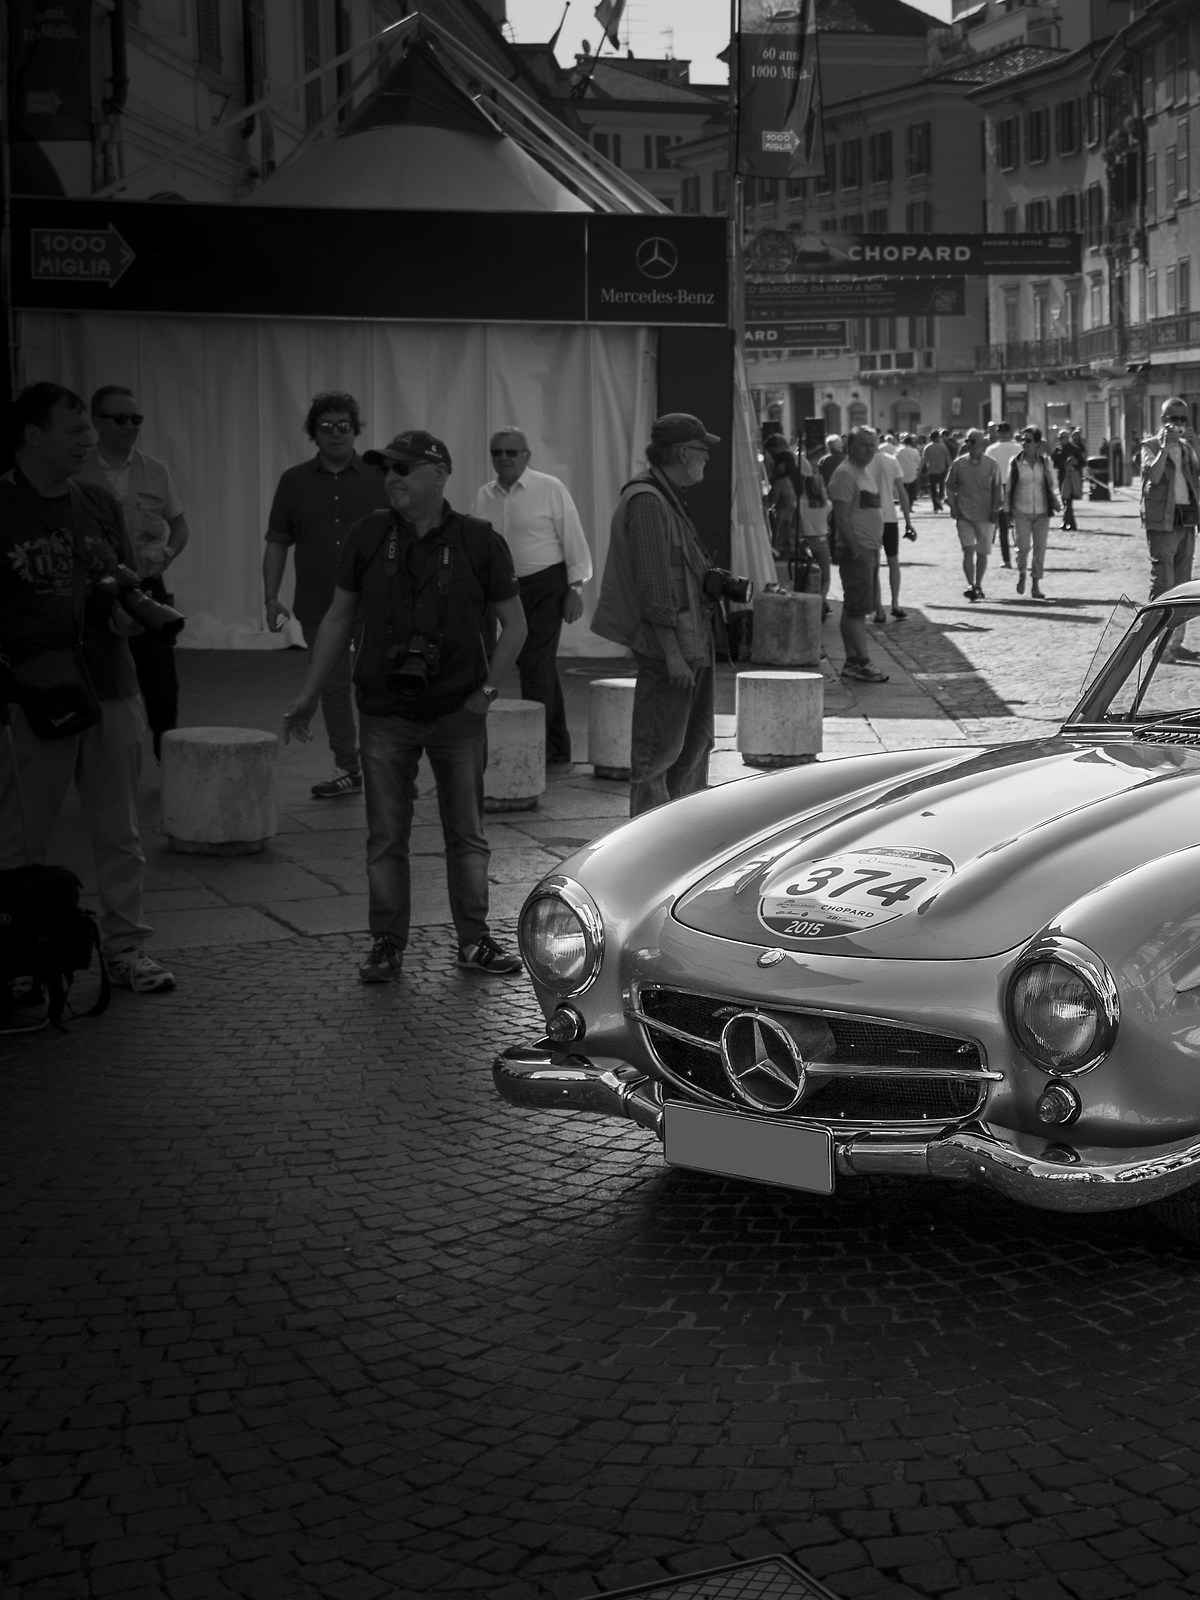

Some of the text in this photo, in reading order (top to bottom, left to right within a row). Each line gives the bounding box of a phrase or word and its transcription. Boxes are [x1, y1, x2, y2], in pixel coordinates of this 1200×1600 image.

[762, 46, 777, 60] 60
[751, 66, 778, 79] 1000
[42, 235, 107, 253] 1000
[849, 246, 972, 262] CHOPARD
[38, 258, 111, 275] MIGLIA
[600, 288, 716, 305] Mercedes-Benz
[786, 867, 927, 907] 374
[820, 904, 875, 918] CHOPARD
[783, 920, 825, 936] 2015
